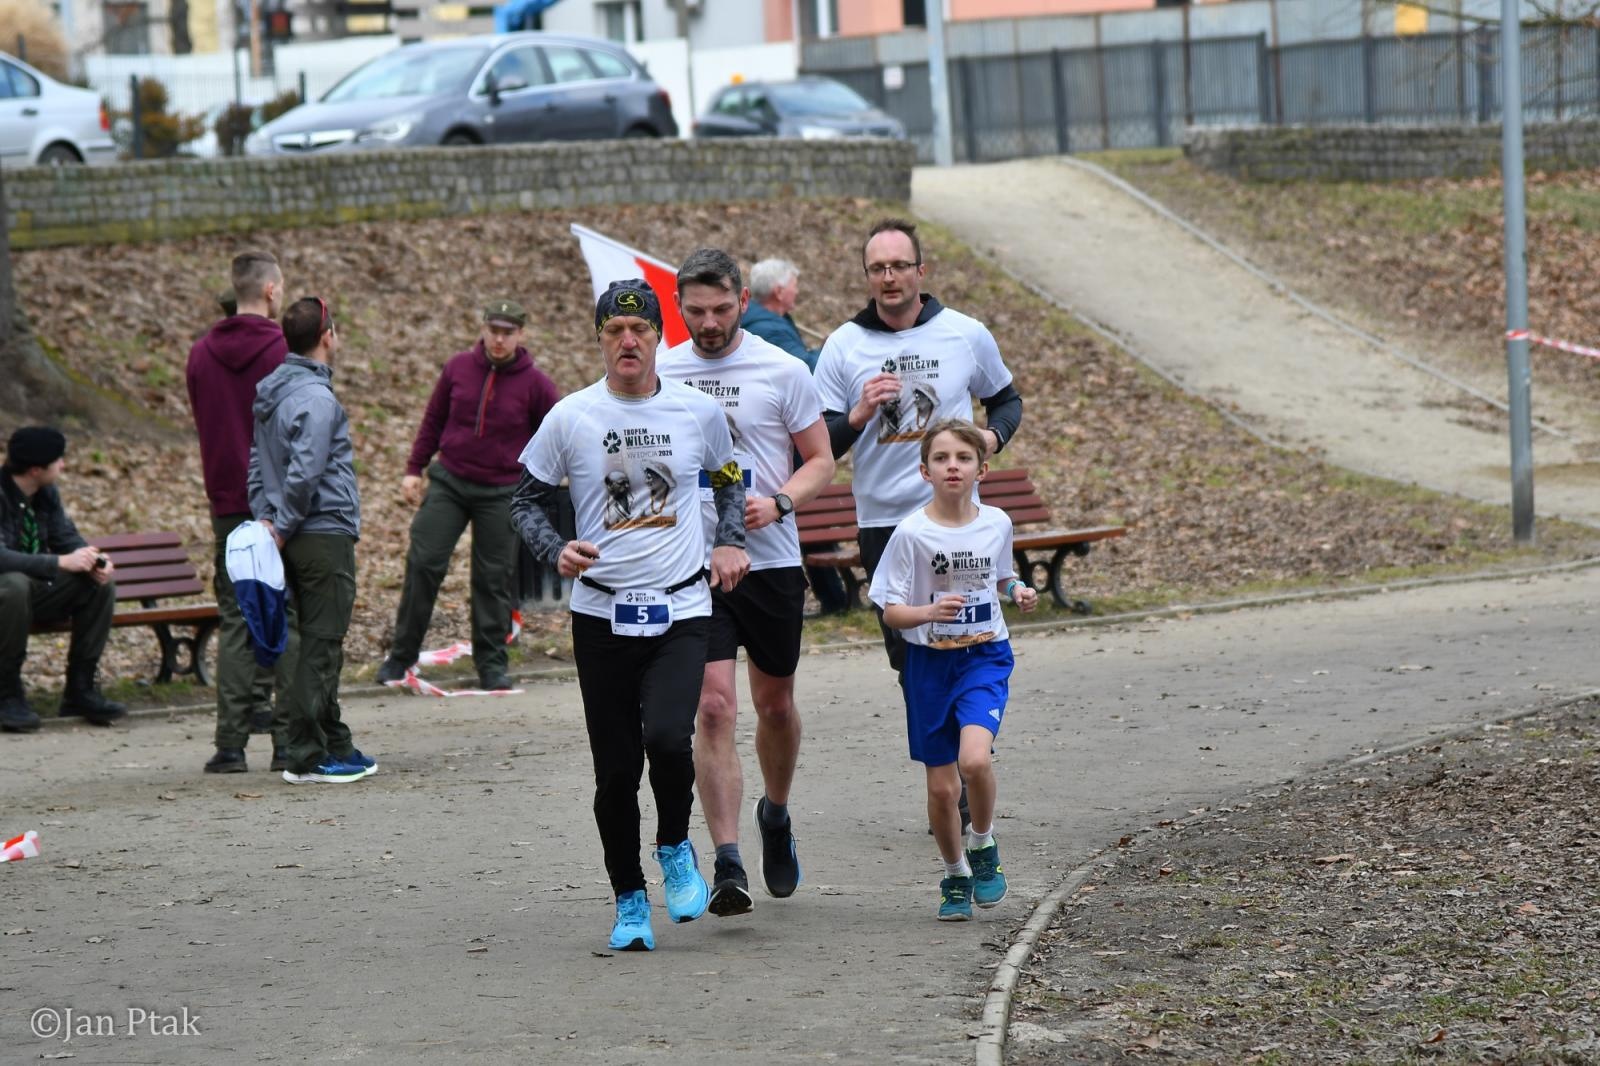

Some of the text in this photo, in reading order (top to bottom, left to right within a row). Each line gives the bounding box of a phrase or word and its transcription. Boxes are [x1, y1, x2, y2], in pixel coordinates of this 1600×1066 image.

[900, 360, 939, 371] WILCZYM
[625, 434, 671, 447] WILCZYM
[953, 557, 991, 569] WILCZYM
[637, 606, 649, 623] 5
[956, 606, 976, 623] 41
